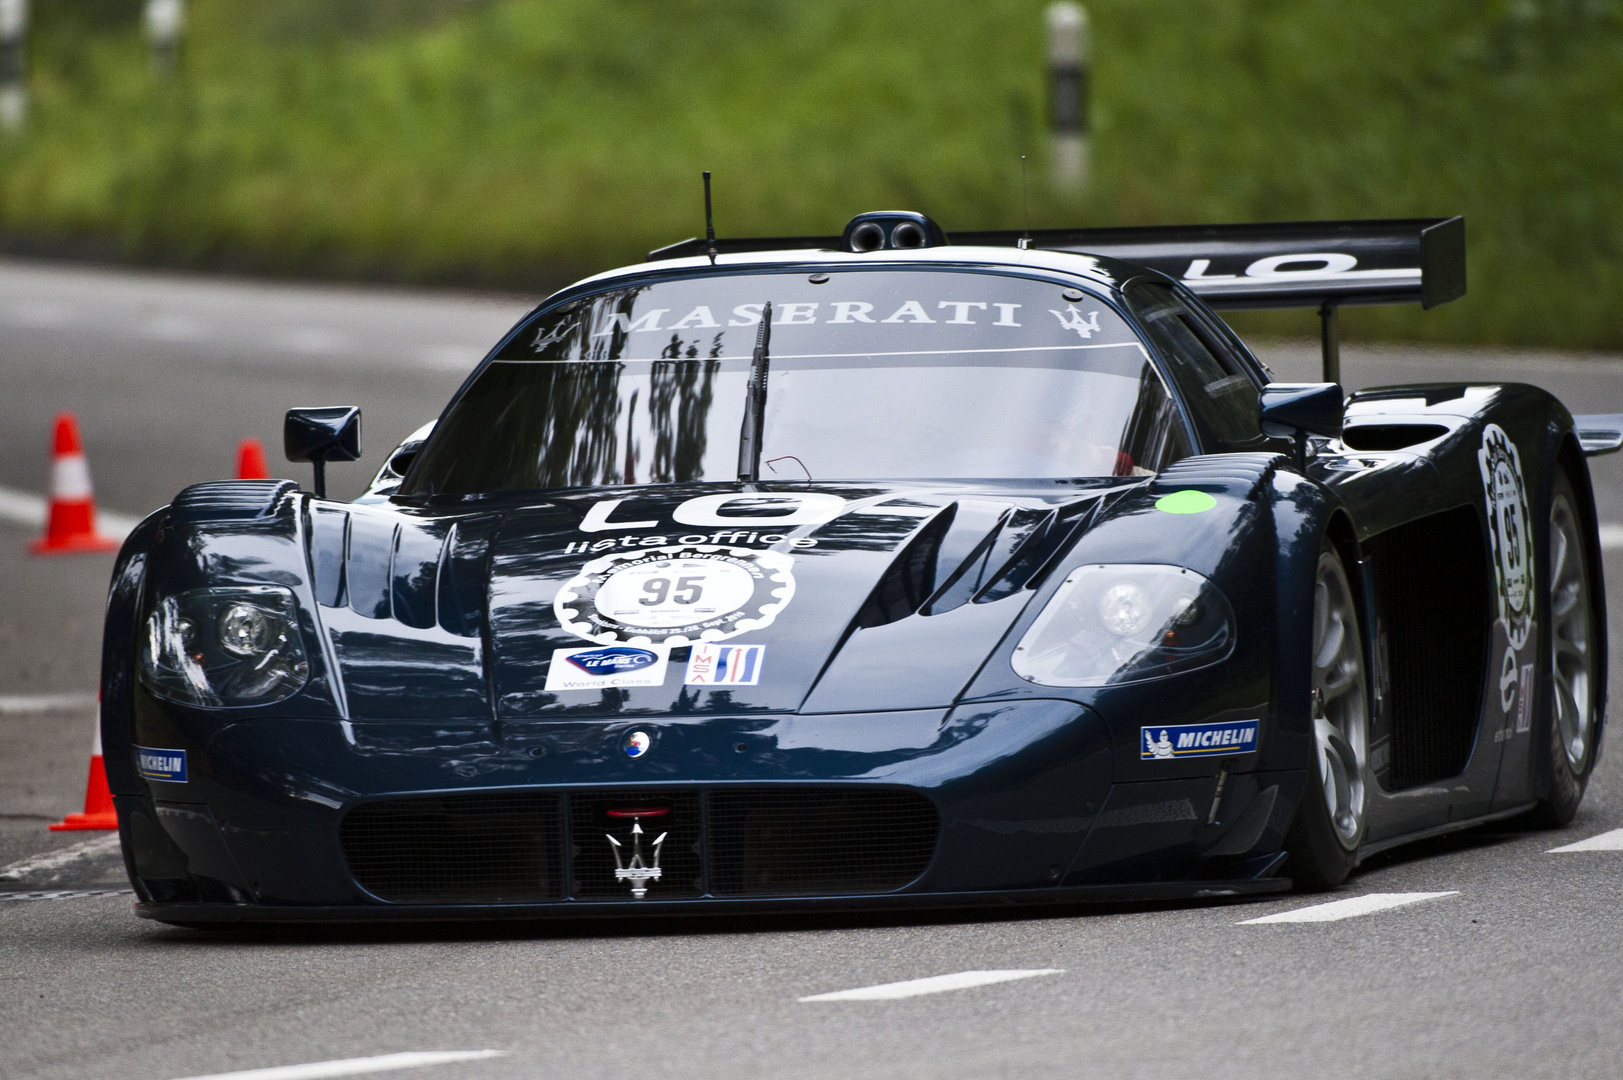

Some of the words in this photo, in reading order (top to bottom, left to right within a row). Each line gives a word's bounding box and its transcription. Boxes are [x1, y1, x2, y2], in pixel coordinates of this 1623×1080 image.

[592, 301, 1022, 338] MASERATI
[678, 530, 818, 549] office
[1503, 504, 1521, 569] 95
[638, 575, 707, 607] 95
[585, 660, 601, 668] LE
[563, 679, 605, 688] World
[611, 678, 652, 686] Class
[1177, 727, 1255, 748] MICHELIN
